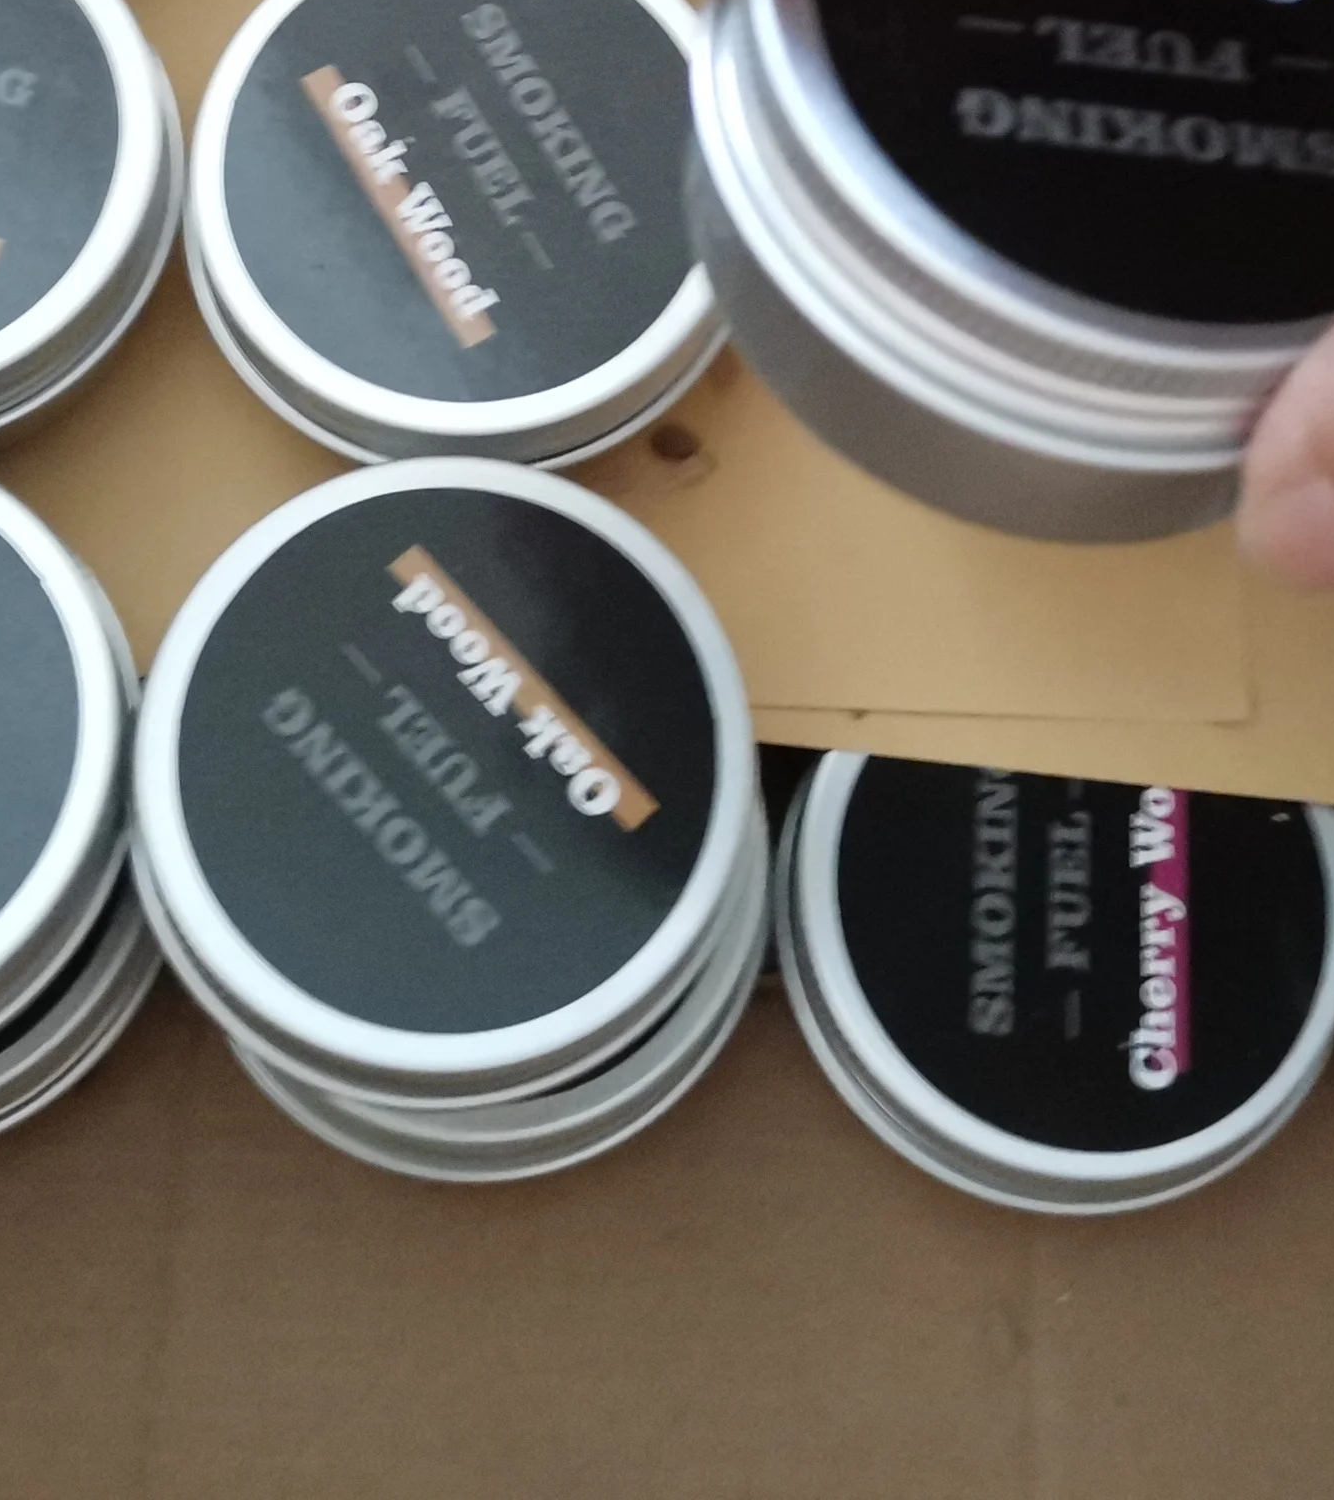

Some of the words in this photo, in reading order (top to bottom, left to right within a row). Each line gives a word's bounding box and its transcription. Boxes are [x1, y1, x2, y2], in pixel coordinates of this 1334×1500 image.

[460, 2, 638, 245] SMOKING
[1030, 12, 1258, 88] FUEL
[331, 81, 417, 184] Oak
[396, 180, 501, 317] Wood
[429, 86, 536, 229] FUEL
[389, 572, 524, 718] Wood
[261, 687, 504, 948] SMOKING
[375, 683, 515, 839] FUEL
[516, 702, 623, 818] Oak
[1128, 785, 1176, 869] Wo
[967, 767, 1020, 1037] SMOKIN
[1043, 809, 1093, 972] FUEL
[1129, 882, 1187, 1091] Cherry
